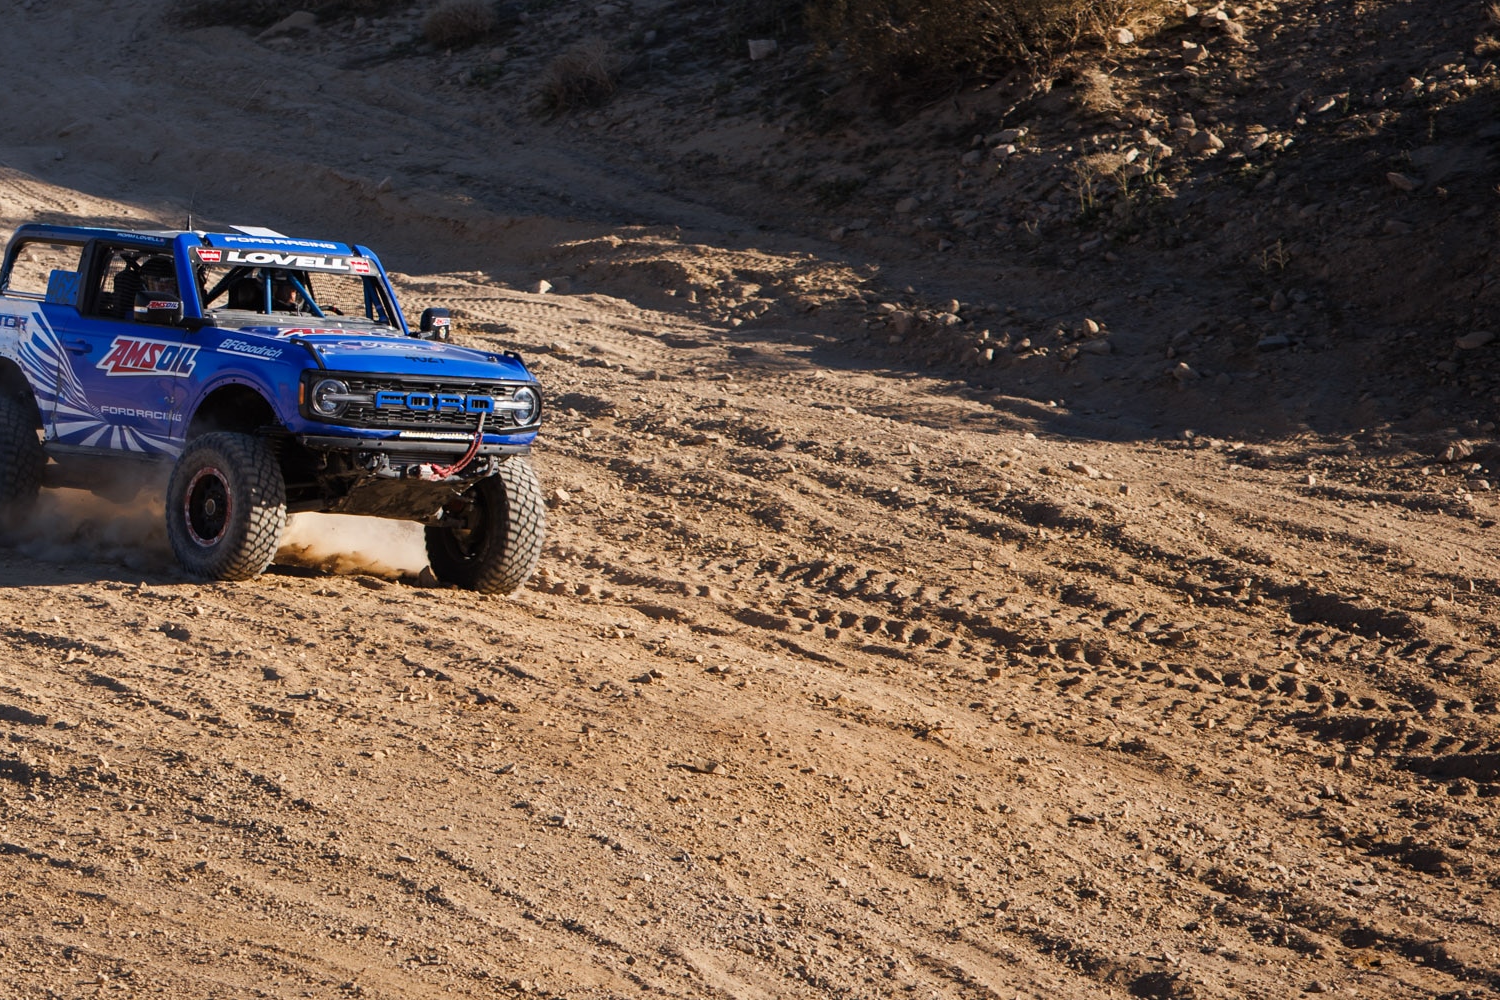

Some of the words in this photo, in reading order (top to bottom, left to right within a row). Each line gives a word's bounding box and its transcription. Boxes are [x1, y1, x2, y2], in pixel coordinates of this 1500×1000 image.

[135, 234, 160, 242] LOVELL
[226, 251, 350, 271] LOVELL
[150, 301, 178, 309] AMSOIL
[100, 338, 198, 374] AMSOIL
[219, 338, 283, 358] BFGoodrich
[376, 390, 495, 414] FORD
